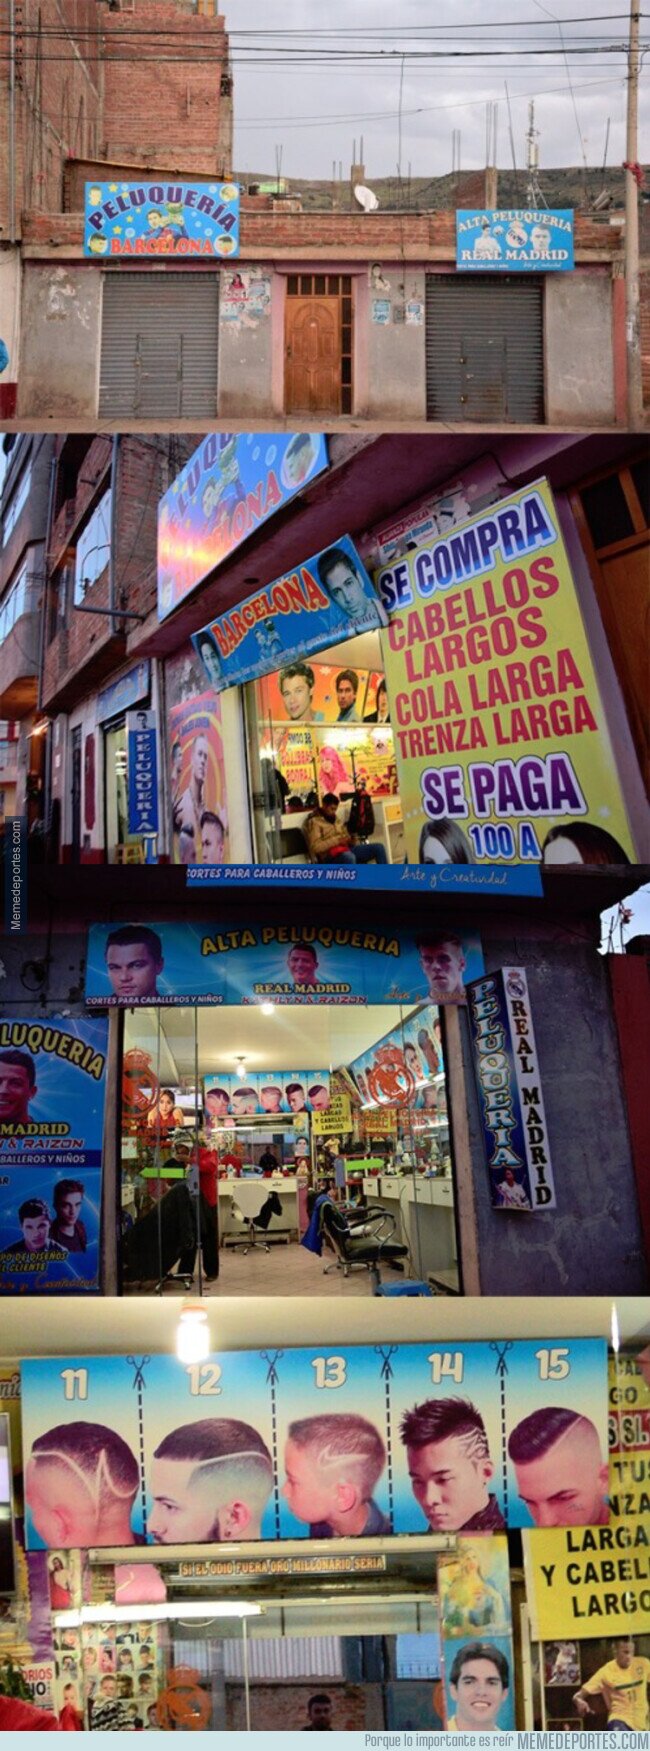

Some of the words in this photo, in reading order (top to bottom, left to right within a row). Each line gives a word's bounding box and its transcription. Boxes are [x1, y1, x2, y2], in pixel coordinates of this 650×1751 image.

[88, 187, 236, 232] PELUQUERÍA
[458, 215, 489, 233] ALTA
[492, 211, 572, 232] PELUQUERIA
[111, 238, 213, 254] BARCELONA
[461, 250, 502, 260] REAL
[505, 250, 569, 260] MADRID
[380, 566, 411, 610] SE
[416, 497, 554, 596] COMPRA
[211, 567, 330, 658] BARCELONA
[388, 556, 559, 652] CABELLOS
[405, 607, 547, 683] LARGOS
[395, 681, 462, 726] COLA
[468, 649, 583, 710] LARGA
[397, 718, 488, 760] TRENZA
[492, 694, 598, 745] LARGA
[135, 734, 153, 831] PELUQUERIA
[422, 766, 467, 817] SE
[469, 752, 583, 815] PAGA
[470, 824, 512, 859] 100
[518, 823, 542, 860] A
[225, 868, 250, 878] PARA
[254, 868, 314, 879] CABALLEROS
[316, 869, 323, 879] Y
[326, 868, 356, 880] NIÑOS
[401, 867, 425, 880] Arte
[430, 874, 438, 888] y
[439, 867, 507, 885] Creatividad
[201, 930, 256, 956] ALTA
[262, 926, 400, 957] PELUQUERIA
[86, 997, 117, 1005] CORTES
[118, 996, 139, 1004] PARA
[141, 995, 189, 1003] CABALLEROS
[198, 993, 223, 1003] NIÑOS
[254, 984, 291, 994] REAL
[294, 984, 350, 994] MADRID
[0, 1024, 104, 1079] LUQUERIA
[511, 1000, 533, 1073] REAL
[472, 980, 524, 1168] PELUQUERIA
[0, 1123, 70, 1135] MADRID
[8, 1139, 16, 1149] &
[24, 1139, 84, 1149] RAIZON
[47, 1155, 55, 1163] Y
[55, 1153, 86, 1163] NIÑOS
[521, 1086, 553, 1206] MADRID
[185, 1363, 222, 1396] 12
[310, 1355, 347, 1389] 13
[427, 1351, 464, 1384] 14
[535, 1348, 570, 1381] 15
[60, 1368, 88, 1400] 11
[566, 1525, 649, 1553] LARGA
[182, 1563, 192, 1576] SI
[195, 1563, 208, 1576] EL
[210, 1562, 233, 1575] ODIO
[235, 1561, 268, 1574] FUERA
[270, 1559, 289, 1572] ORO
[292, 1557, 351, 1572] MILLONARIO
[353, 1556, 384, 1570] SERIA
[540, 1564, 555, 1587] Y
[566, 1558, 650, 1586] CABEL
